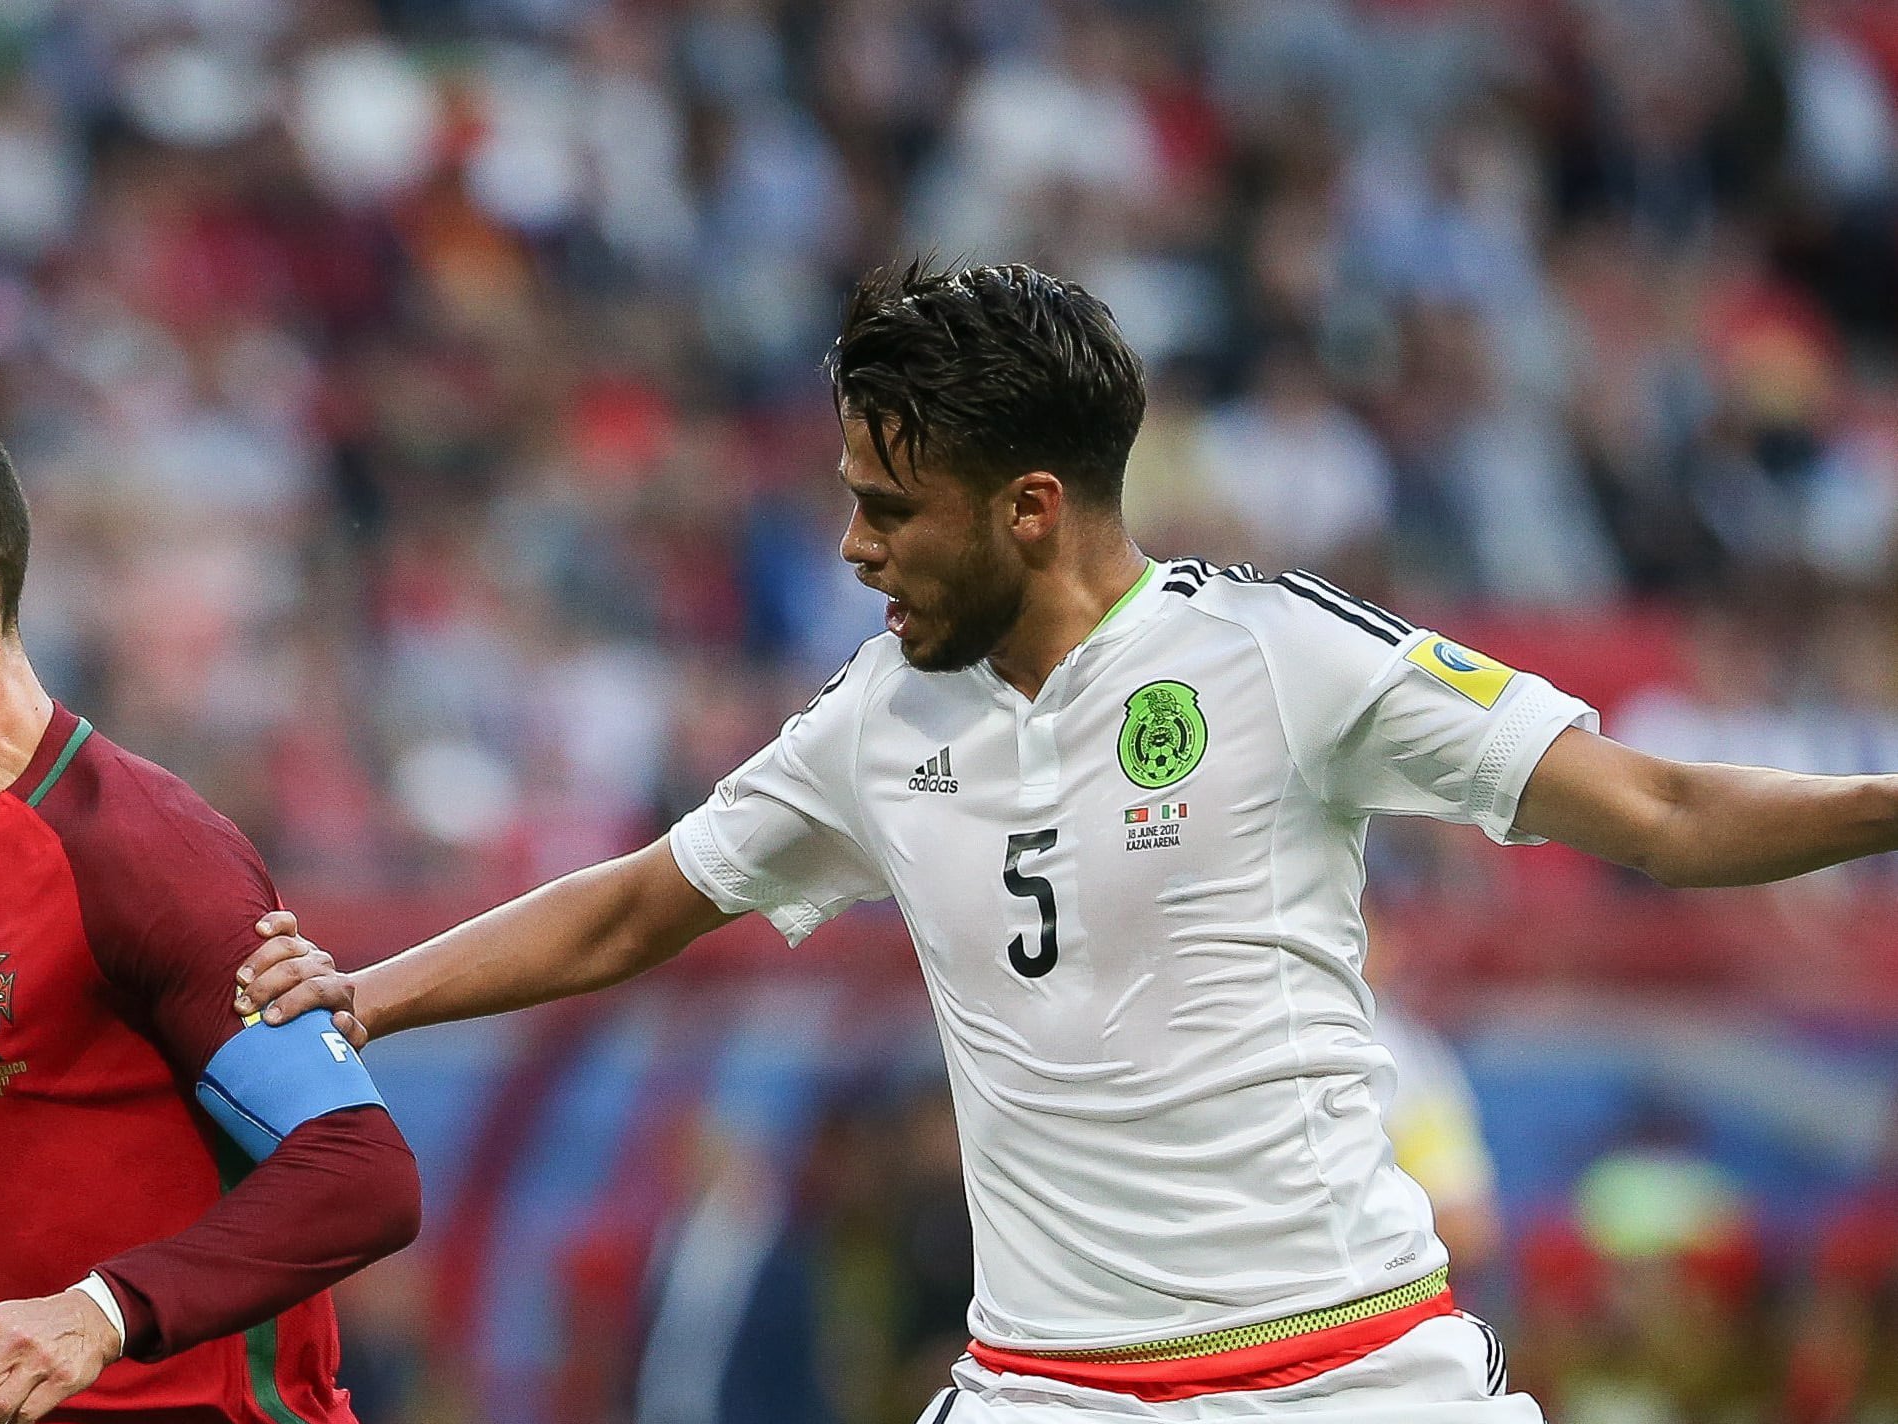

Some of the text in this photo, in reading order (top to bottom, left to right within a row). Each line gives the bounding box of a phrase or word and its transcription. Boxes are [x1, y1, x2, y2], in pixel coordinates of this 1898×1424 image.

[908, 774, 959, 794] adidas
[1138, 826, 1159, 838] JUNE
[1160, 824, 1180, 836] 2017
[1126, 835, 1181, 851] KAZAN ARENA
[1003, 828, 1059, 979] 5
